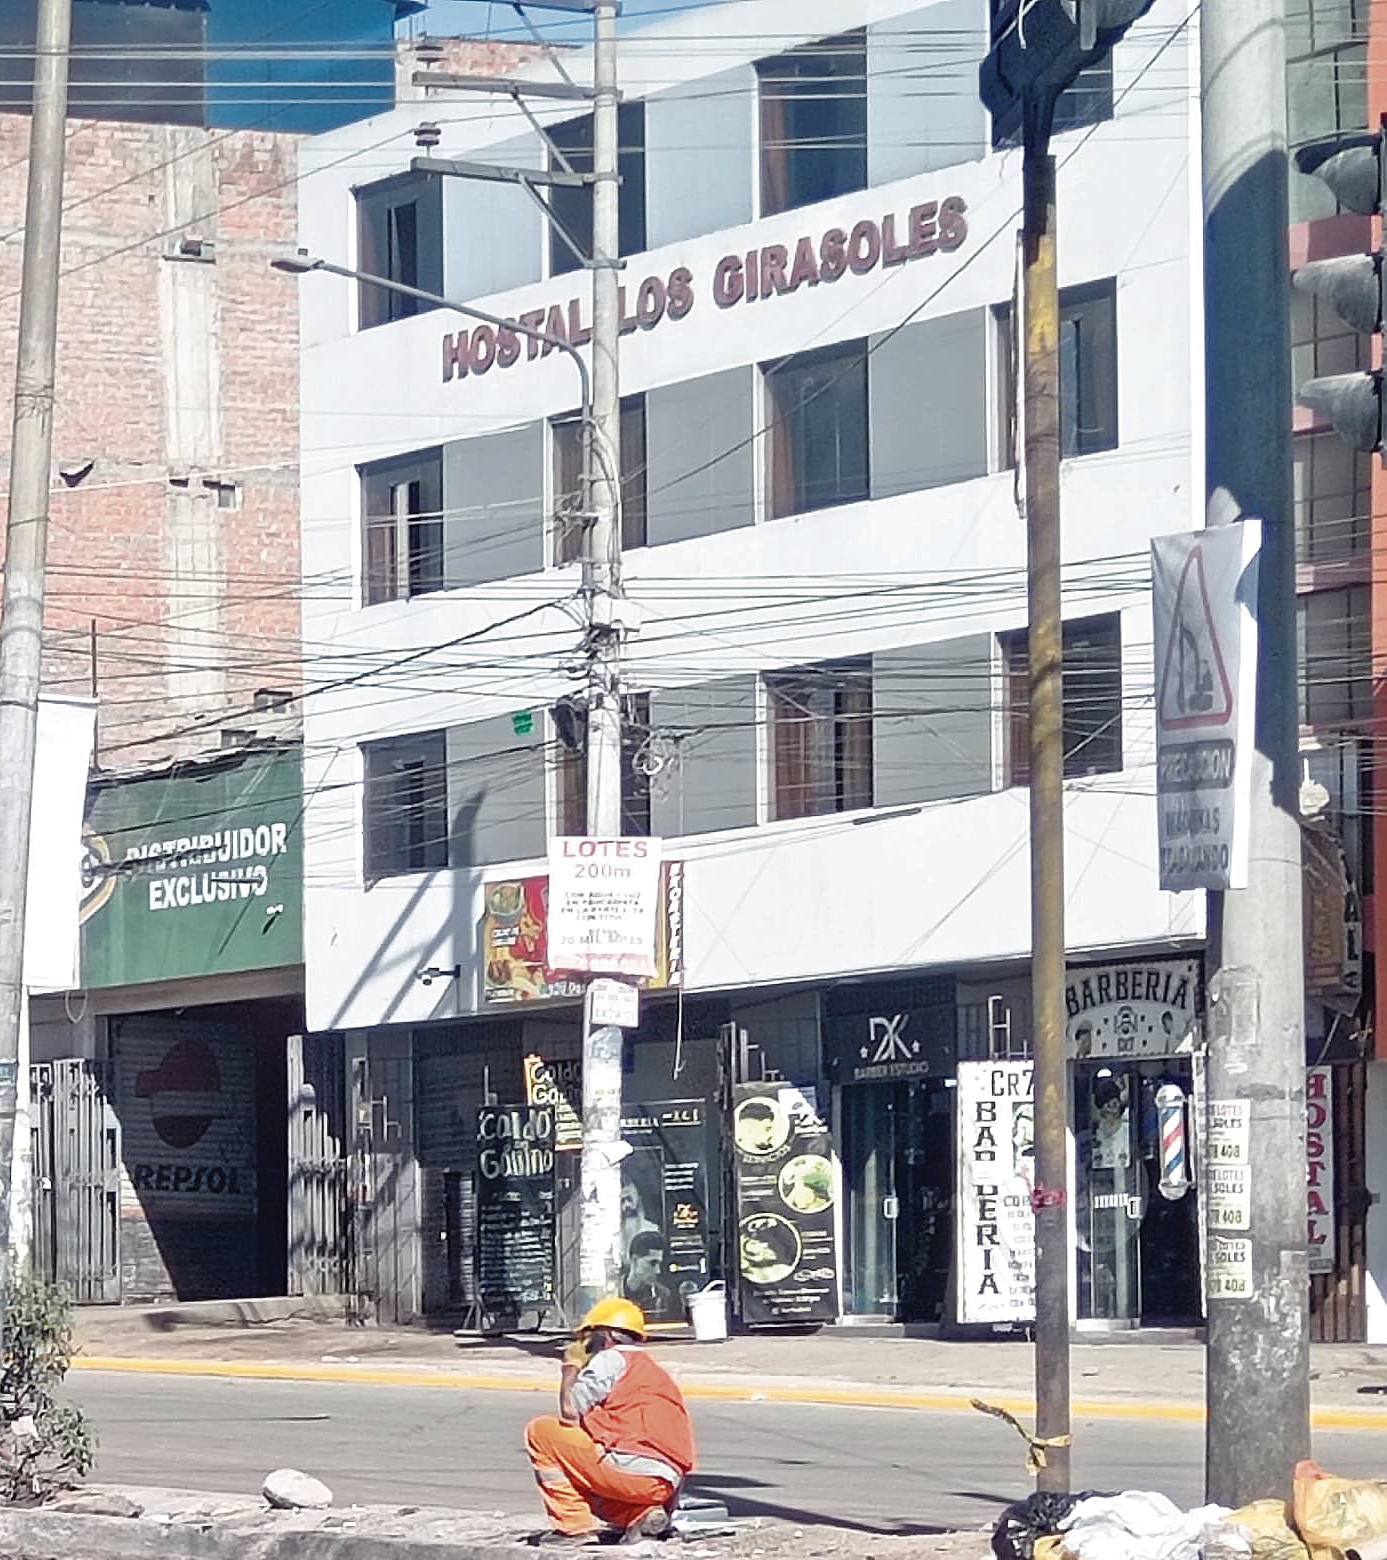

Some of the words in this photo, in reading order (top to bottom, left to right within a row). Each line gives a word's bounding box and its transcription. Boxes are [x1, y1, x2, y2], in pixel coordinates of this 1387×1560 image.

[442, 295, 594, 384] HOSTAL
[618, 267, 694, 337] LOS
[714, 196, 969, 310] GIRASOLES
[127, 823, 287, 876] DISTRIBUIDOR
[563, 841, 648, 858] LOTES
[574, 864, 631, 878] 200m
[149, 865, 268, 910] EXCLUSIVO
[1065, 970, 1188, 1017] BARBERIA
[135, 1164, 242, 1194] REPSOL
